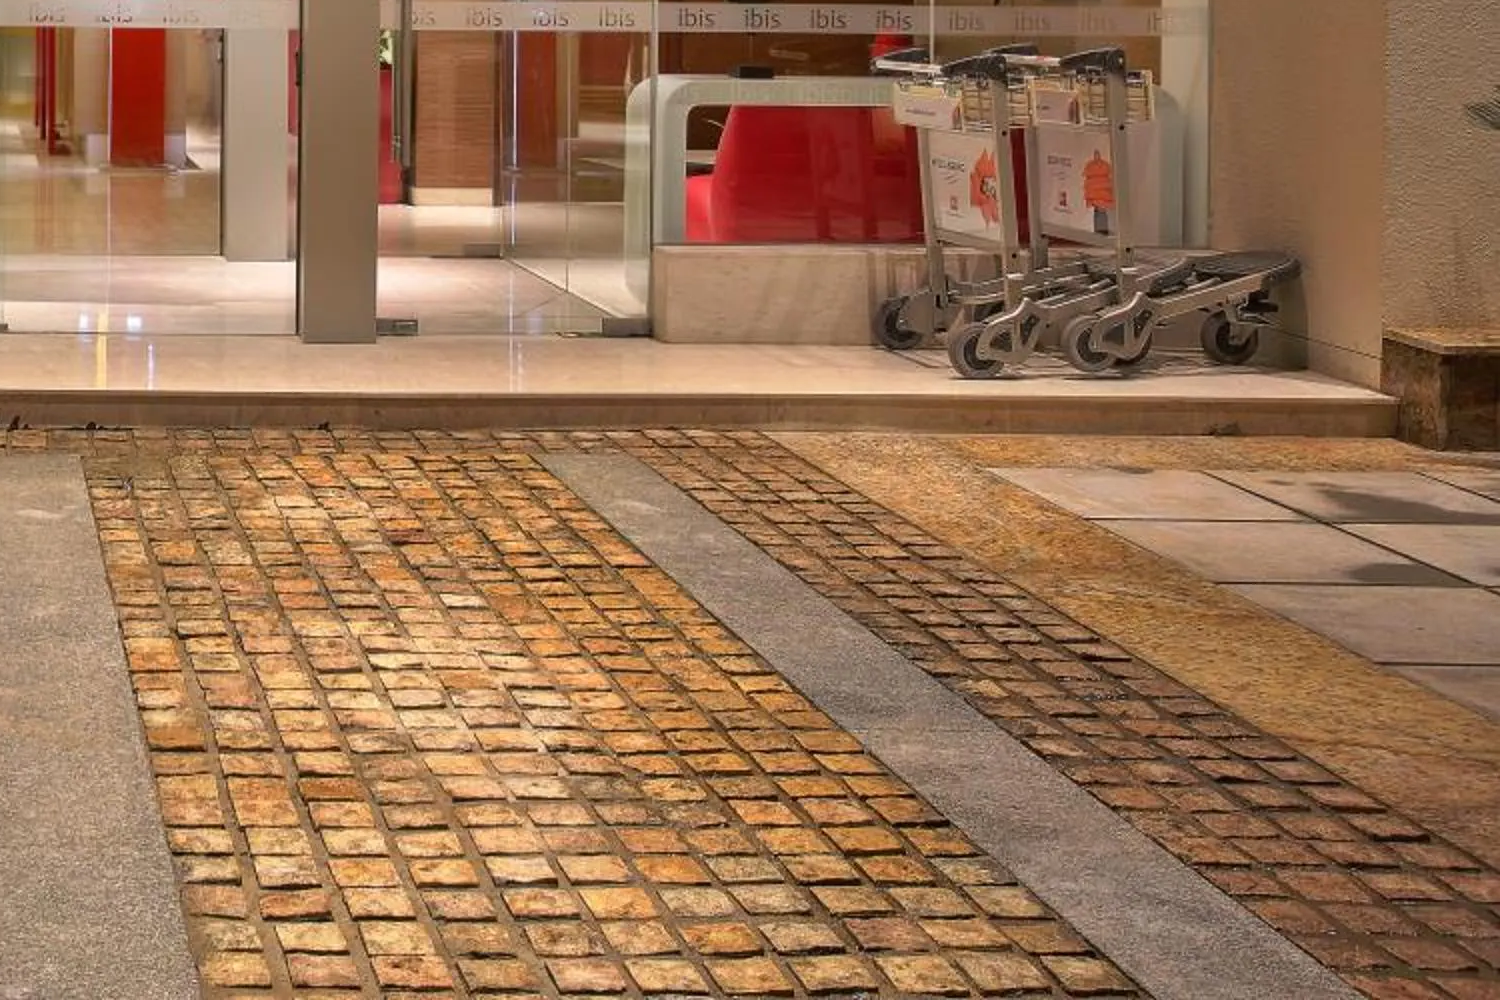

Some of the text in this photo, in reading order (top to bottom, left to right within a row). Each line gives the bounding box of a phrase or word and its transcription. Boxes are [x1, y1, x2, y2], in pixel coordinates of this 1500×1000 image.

[466, 5, 503, 27] ibis
[532, 5, 569, 27] ibis
[599, 6, 635, 28] ibis
[678, 7, 913, 31] ibis ibis ibis ibis
[949, 10, 985, 32] ibis
[1015, 11, 1051, 32] ibis
